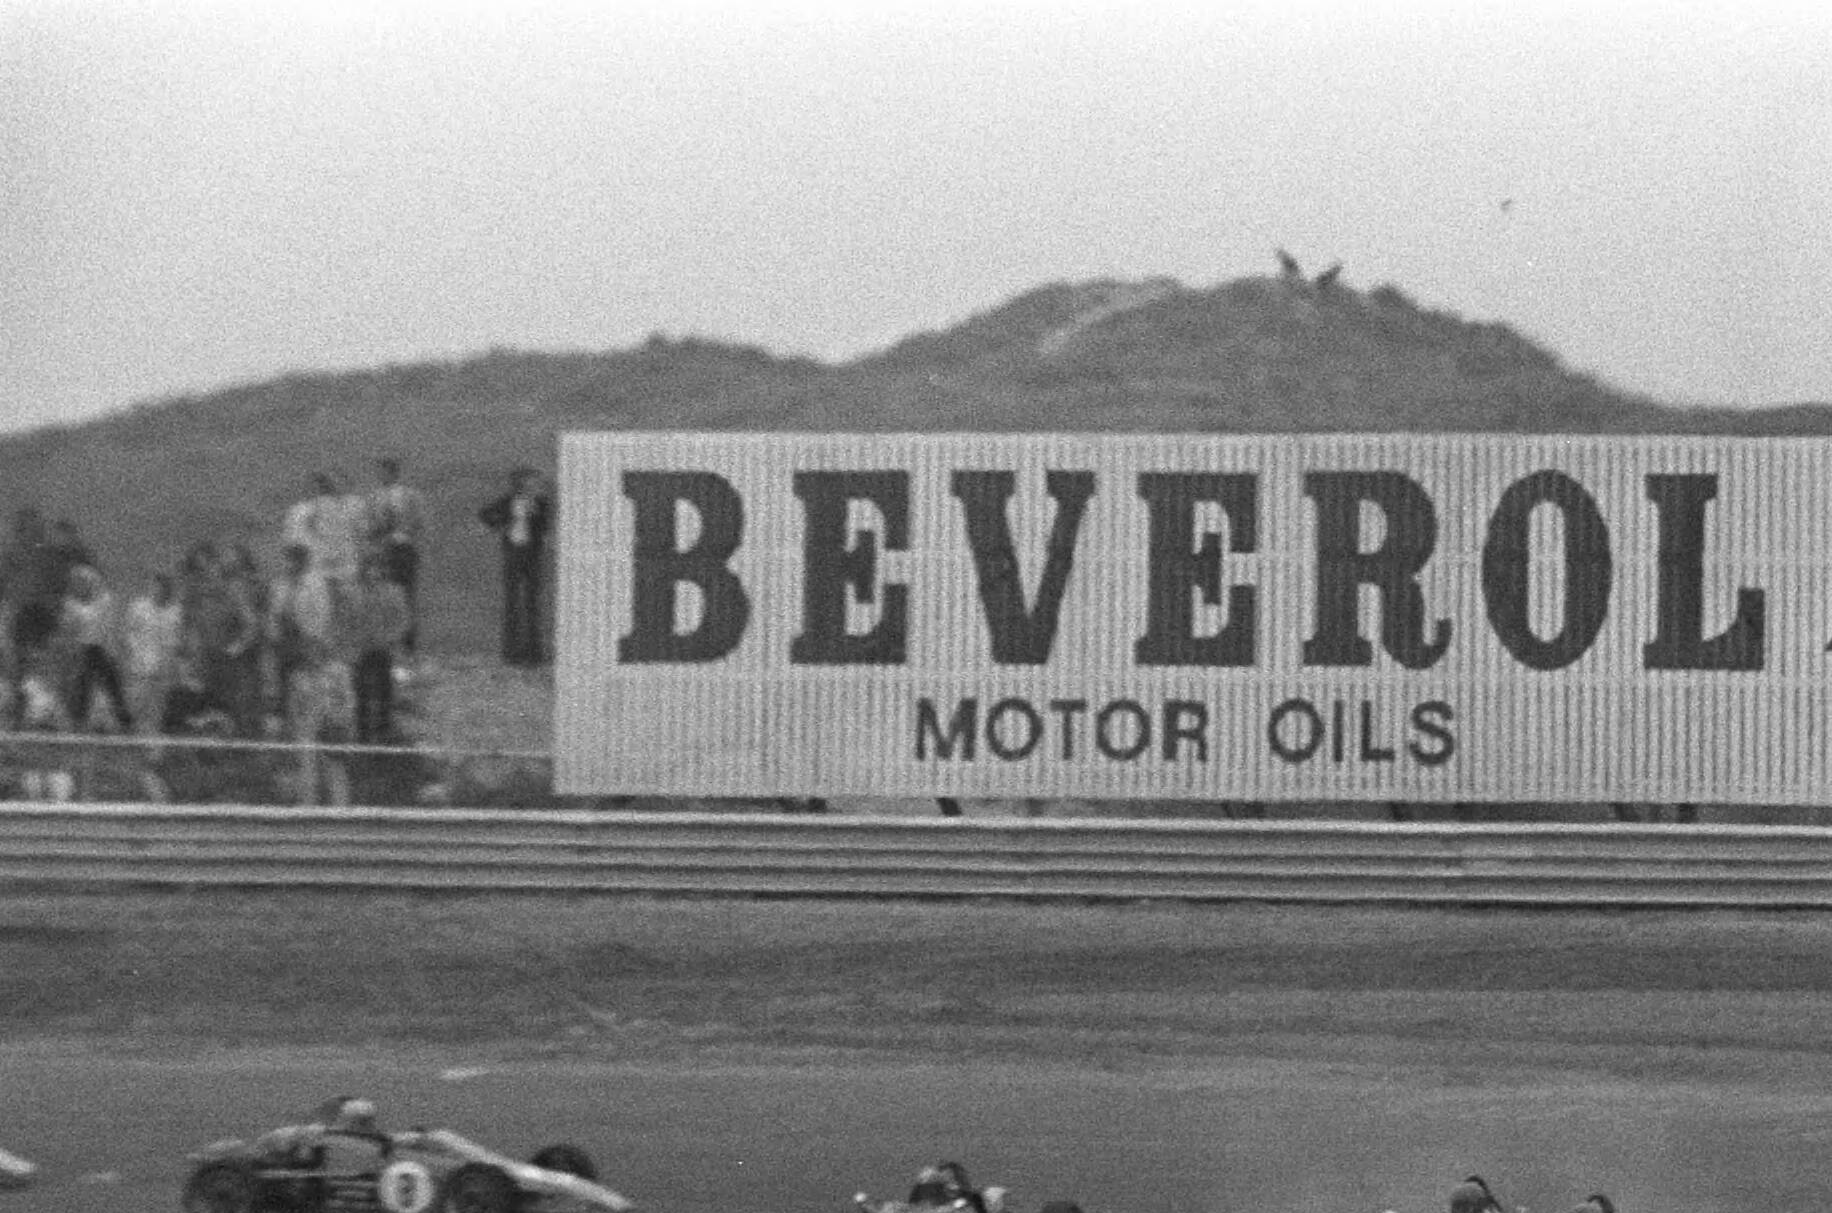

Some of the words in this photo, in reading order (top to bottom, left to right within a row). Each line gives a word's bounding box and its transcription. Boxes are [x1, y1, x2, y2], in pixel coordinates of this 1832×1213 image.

[618, 468, 1766, 673] BEVEROL
[914, 697, 1210, 763] MOTOR
[1267, 697, 1457, 768] OILS
